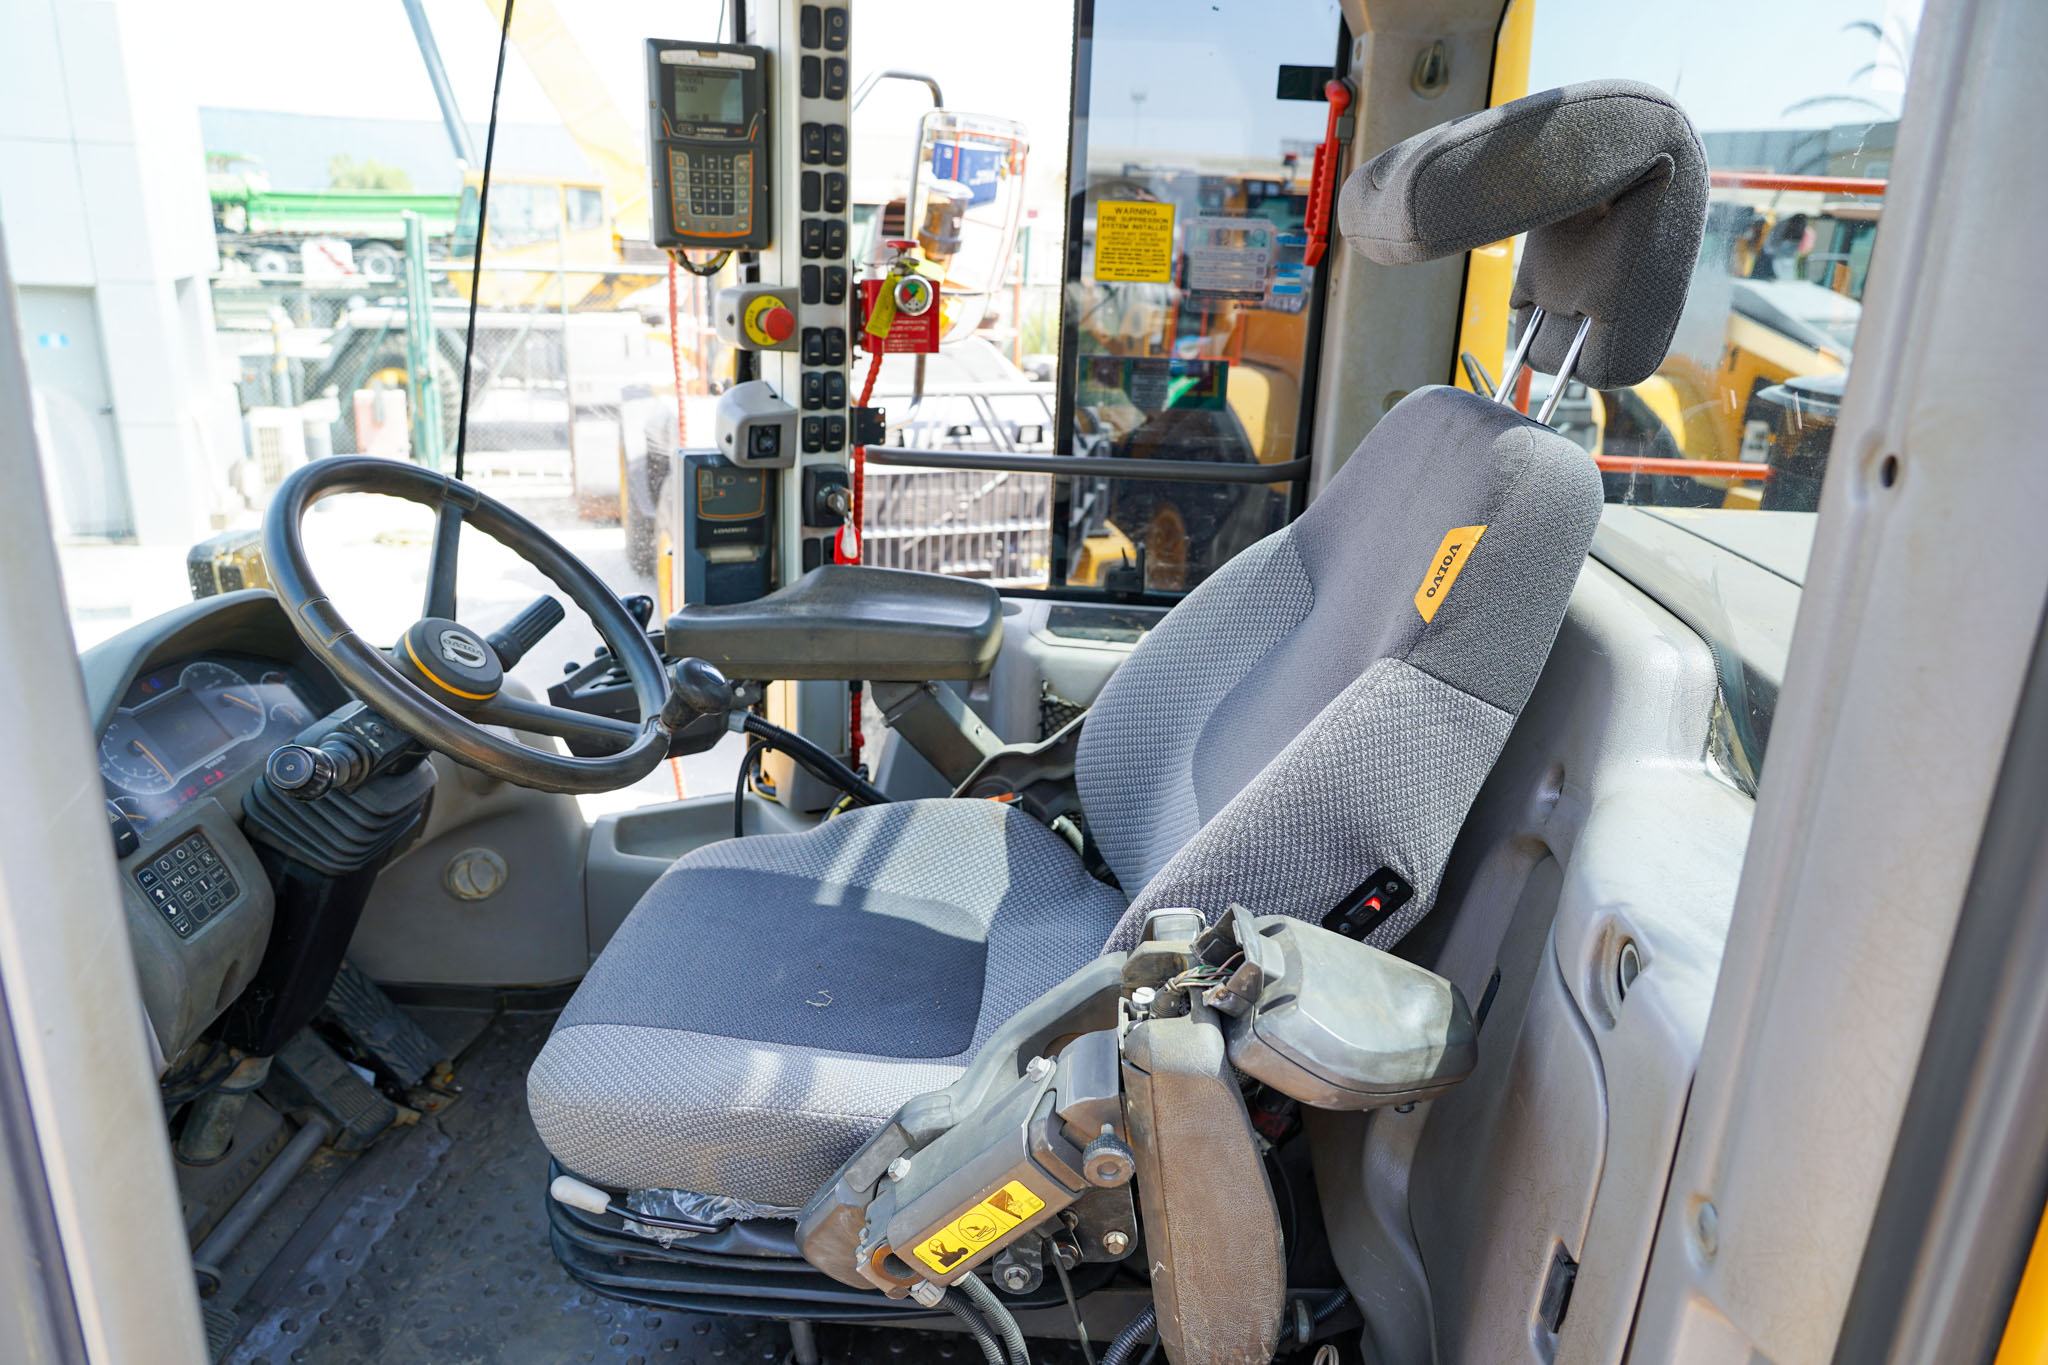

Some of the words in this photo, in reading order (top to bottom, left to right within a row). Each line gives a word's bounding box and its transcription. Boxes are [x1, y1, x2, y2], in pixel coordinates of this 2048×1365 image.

[1114, 207, 1157, 216] WARNING
[1121, 216, 1169, 224] SUPPRESSION
[1132, 224, 1169, 232] INSTALLED
[1426, 543, 1462, 598] VOLVO
[442, 638, 484, 657] VOLVO
[143, 873, 153, 883] ESC
